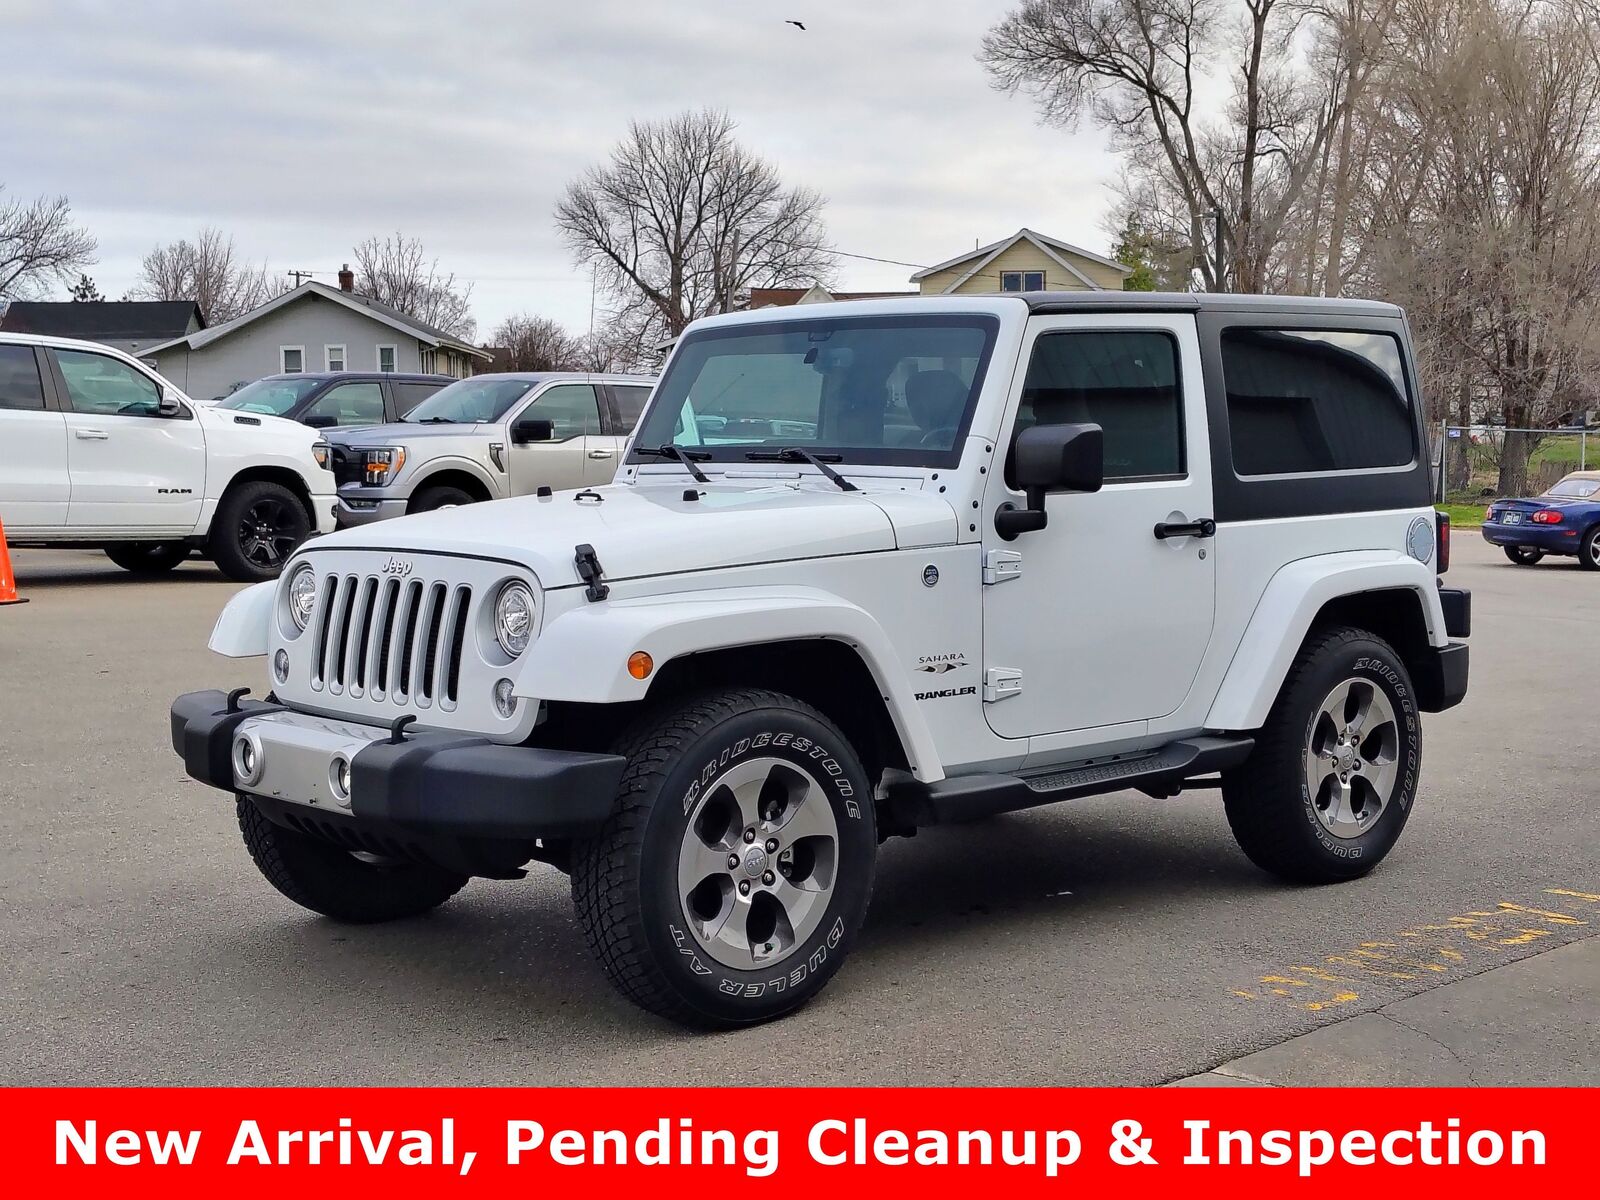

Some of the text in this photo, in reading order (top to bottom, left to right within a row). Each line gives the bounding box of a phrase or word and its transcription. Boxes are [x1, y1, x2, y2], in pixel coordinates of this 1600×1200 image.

[382, 556, 413, 577] Jeep
[919, 653, 965, 663] SAHARA
[914, 686, 977, 701] RANGLER
[1353, 657, 1418, 812] BRIDGESTONE
[684, 732, 861, 820] BRIDGESTONE
[669, 916, 844, 998] DUELER A/T
